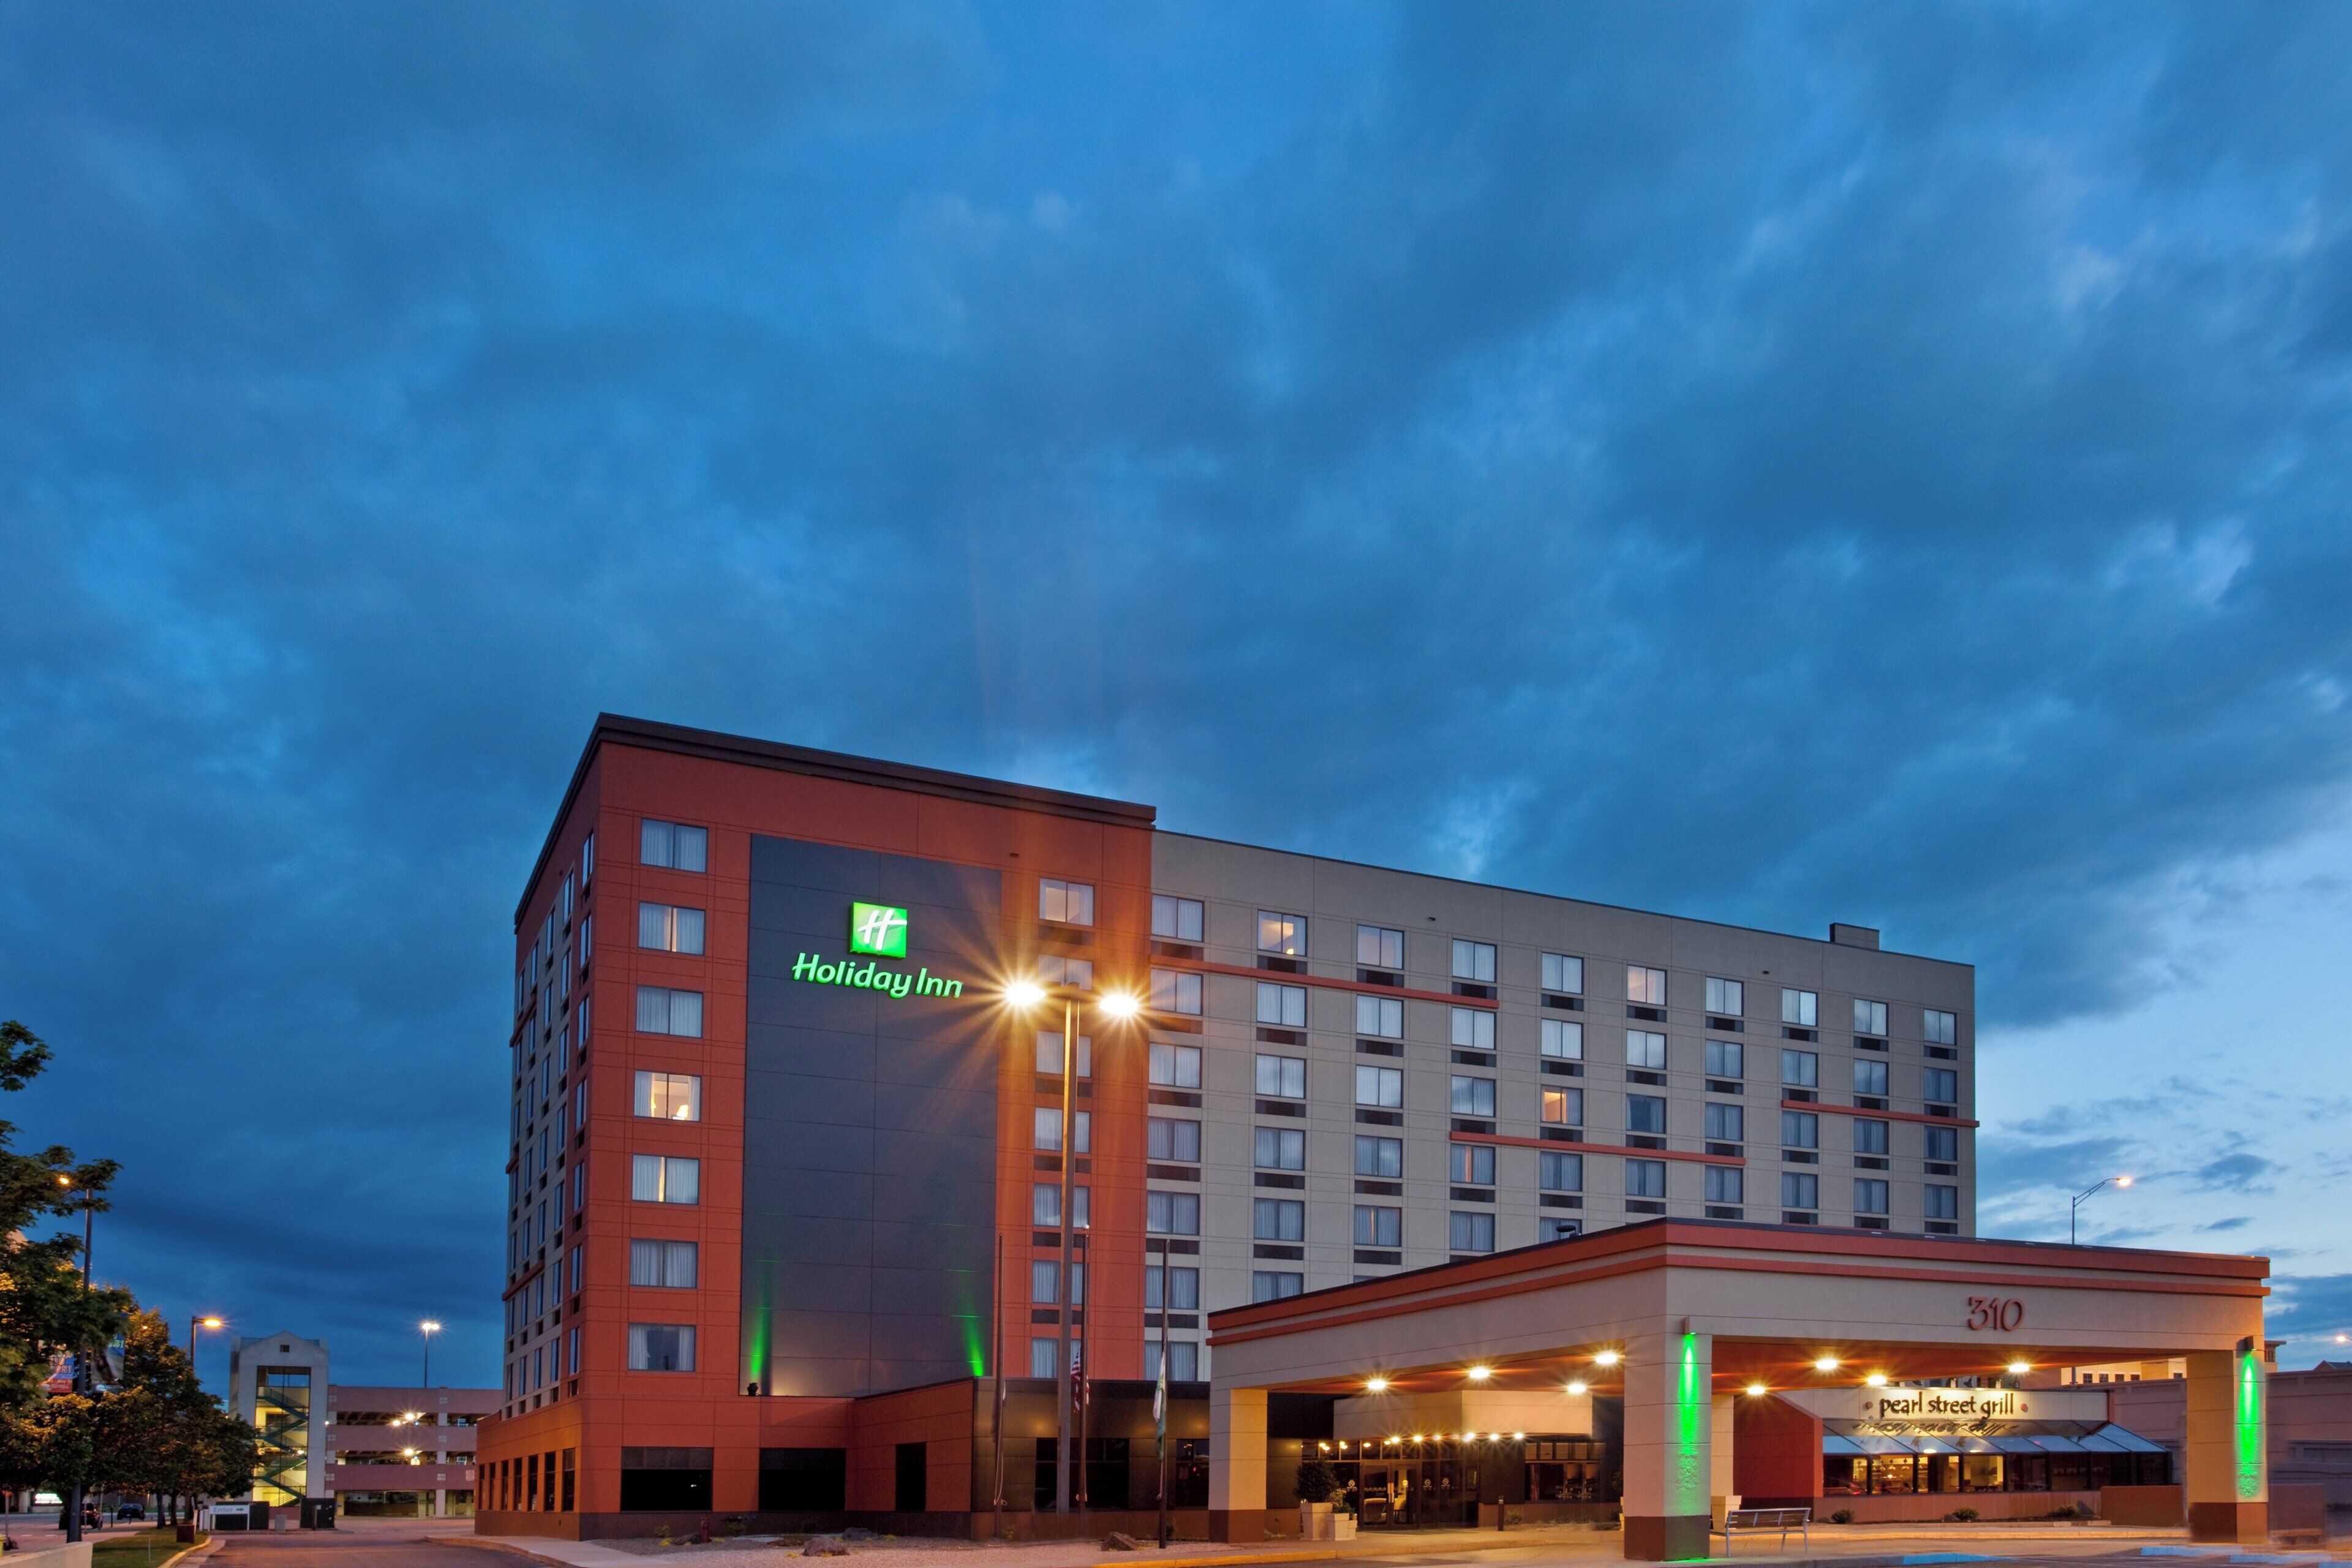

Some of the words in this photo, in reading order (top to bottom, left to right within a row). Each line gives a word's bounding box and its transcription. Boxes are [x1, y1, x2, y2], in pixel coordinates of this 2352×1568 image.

[791, 952, 913, 998] Holiday
[915, 967, 963, 998] Inn
[1967, 1296, 2024, 1331] 310
[1879, 1391, 1923, 1419] pearl
[1928, 1395, 1977, 1414] street
[1980, 1392, 2014, 1420] grill
